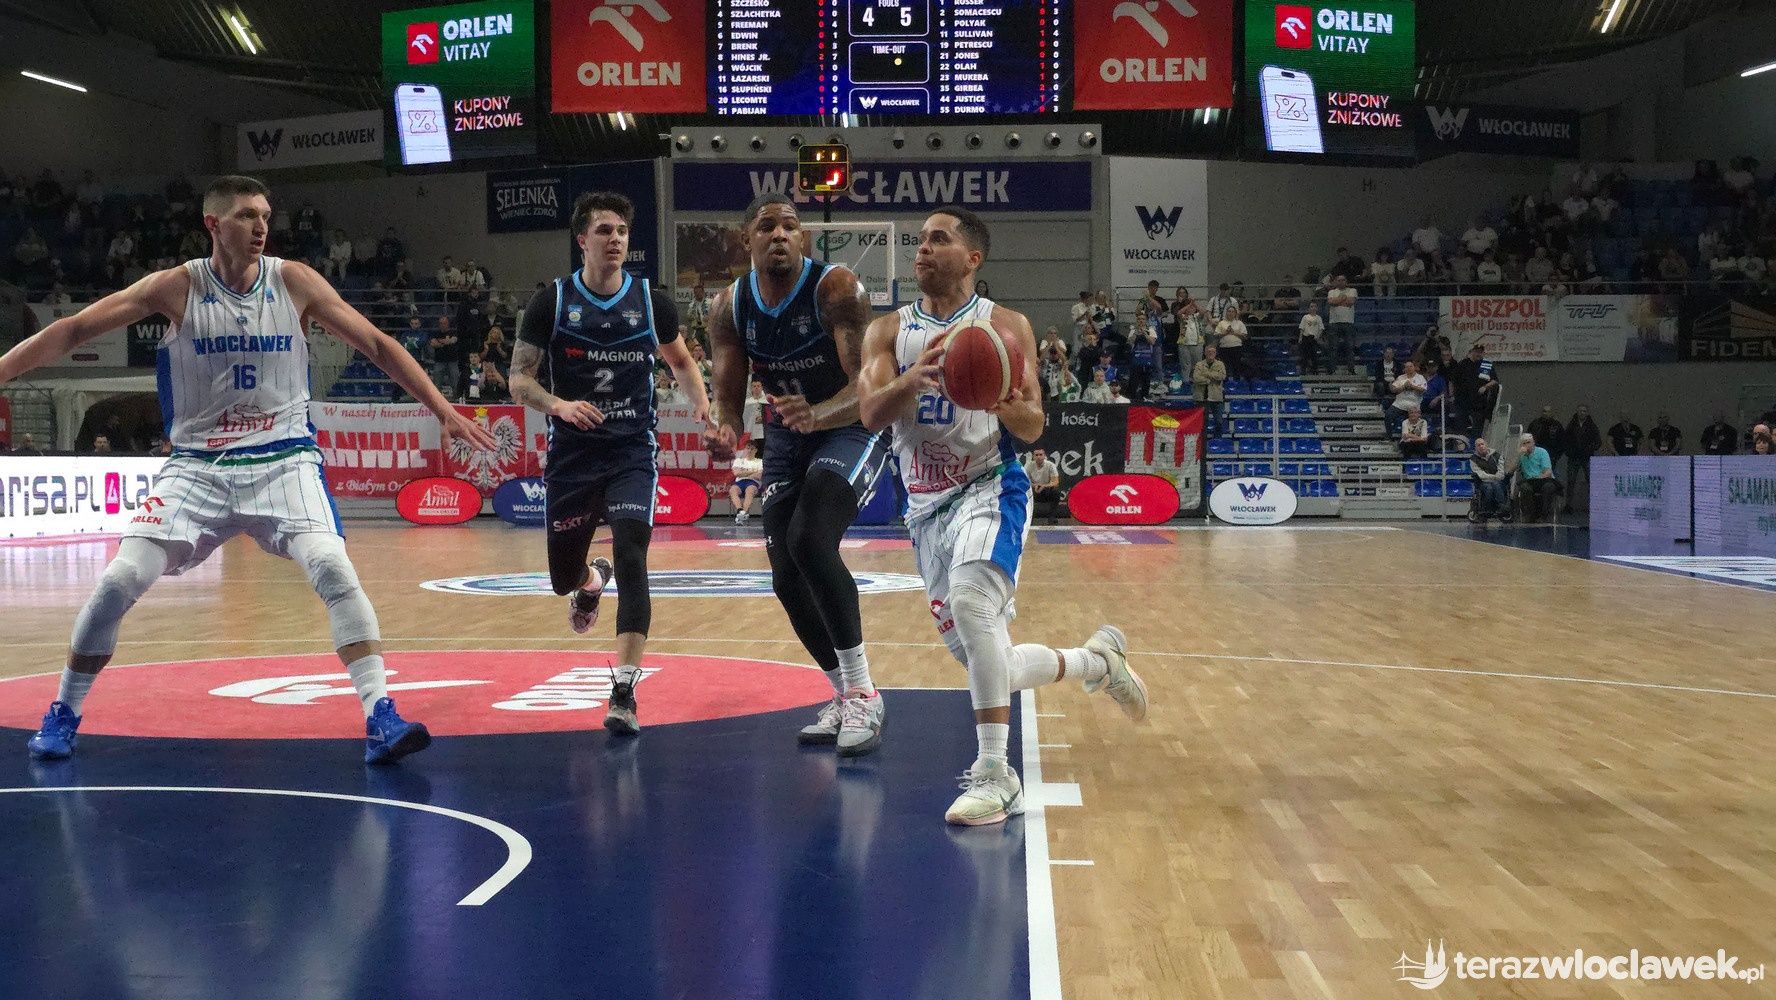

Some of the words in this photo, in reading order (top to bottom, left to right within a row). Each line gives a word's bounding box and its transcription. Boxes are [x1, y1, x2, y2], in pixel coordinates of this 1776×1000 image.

[717, 10, 723, 18] 4
[730, 10, 781, 18] SZLACHETKA
[862, 7, 875, 27] 4
[900, 6, 912, 27] 5
[1317, 8, 1393, 35] ORLEN
[443, 13, 513, 40] ORLEN
[717, 21, 723, 29] 5
[717, 32, 723, 40] 6
[731, 32, 758, 40] EDWIN
[954, 30, 993, 38] SULLIVAN
[444, 42, 490, 62] VITAY
[872, 45, 906, 54] TIME-OUT
[1053, 40, 1059, 48] 0
[1317, 34, 1369, 54] VITAY
[940, 52, 950, 60] 21
[954, 52, 980, 60] JONES
[577, 62, 682, 87] ORLEN
[718, 64, 724, 72] 9
[731, 62, 762, 72] WÓJCIK
[1099, 57, 1207, 83] ORLEN
[819, 74, 825, 82] 0
[731, 84, 772, 93] SŁUPIŃSKI
[832, 85, 839, 93] 0
[954, 84, 984, 92] GIRBEA
[454, 96, 511, 114] KUPONY
[718, 96, 728, 104] 20
[731, 96, 768, 104] LECOMTE
[832, 96, 838, 104] 2
[1053, 94, 1059, 102] 2
[1328, 92, 1390, 109] KUPONY
[940, 106, 950, 114] 55
[954, 106, 986, 114] DURMO
[454, 111, 524, 132] ZNIŻKOWE
[1327, 109, 1402, 128] ZNIŻKOWE
[1478, 118, 1571, 140] WŁOCŁAWEK
[292, 128, 376, 149] WŁOCŁAWEK
[750, 170, 1010, 203] WŁCŁAWEK
[496, 186, 559, 212] SELENKA
[901, 233, 919, 246] Ba
[1123, 249, 1195, 261] WŁOCŁAWEK
[1451, 298, 1546, 319] DUSZPOL
[1451, 319, 1484, 331] Kamil
[1487, 319, 1546, 332] Duszyński
[192, 335, 293, 355] WŁOCŁAWEK
[587, 351, 644, 362] MAGNOR
[768, 354, 825, 372] MAGNOR
[232, 364, 257, 390] 16
[594, 367, 615, 393] 2
[323, 406, 337, 417] W
[341, 406, 377, 421] naszej
[380, 405, 433, 419] hierarchi
[656, 409, 672, 418] est
[674, 410, 688, 418] na
[918, 394, 955, 425] 20
[1061, 412, 1100, 427] kości
[316, 430, 428, 469] ANWIL
[335, 483, 343, 491] z
[346, 479, 386, 494] Białym
[0, 475, 101, 518] risa.PL
[419, 488, 460, 507] Anwil
[512, 504, 546, 512] WŁOCŁA
[1106, 505, 1142, 514] ORLEN
[1229, 505, 1277, 514] WŁOCŁAWEK
